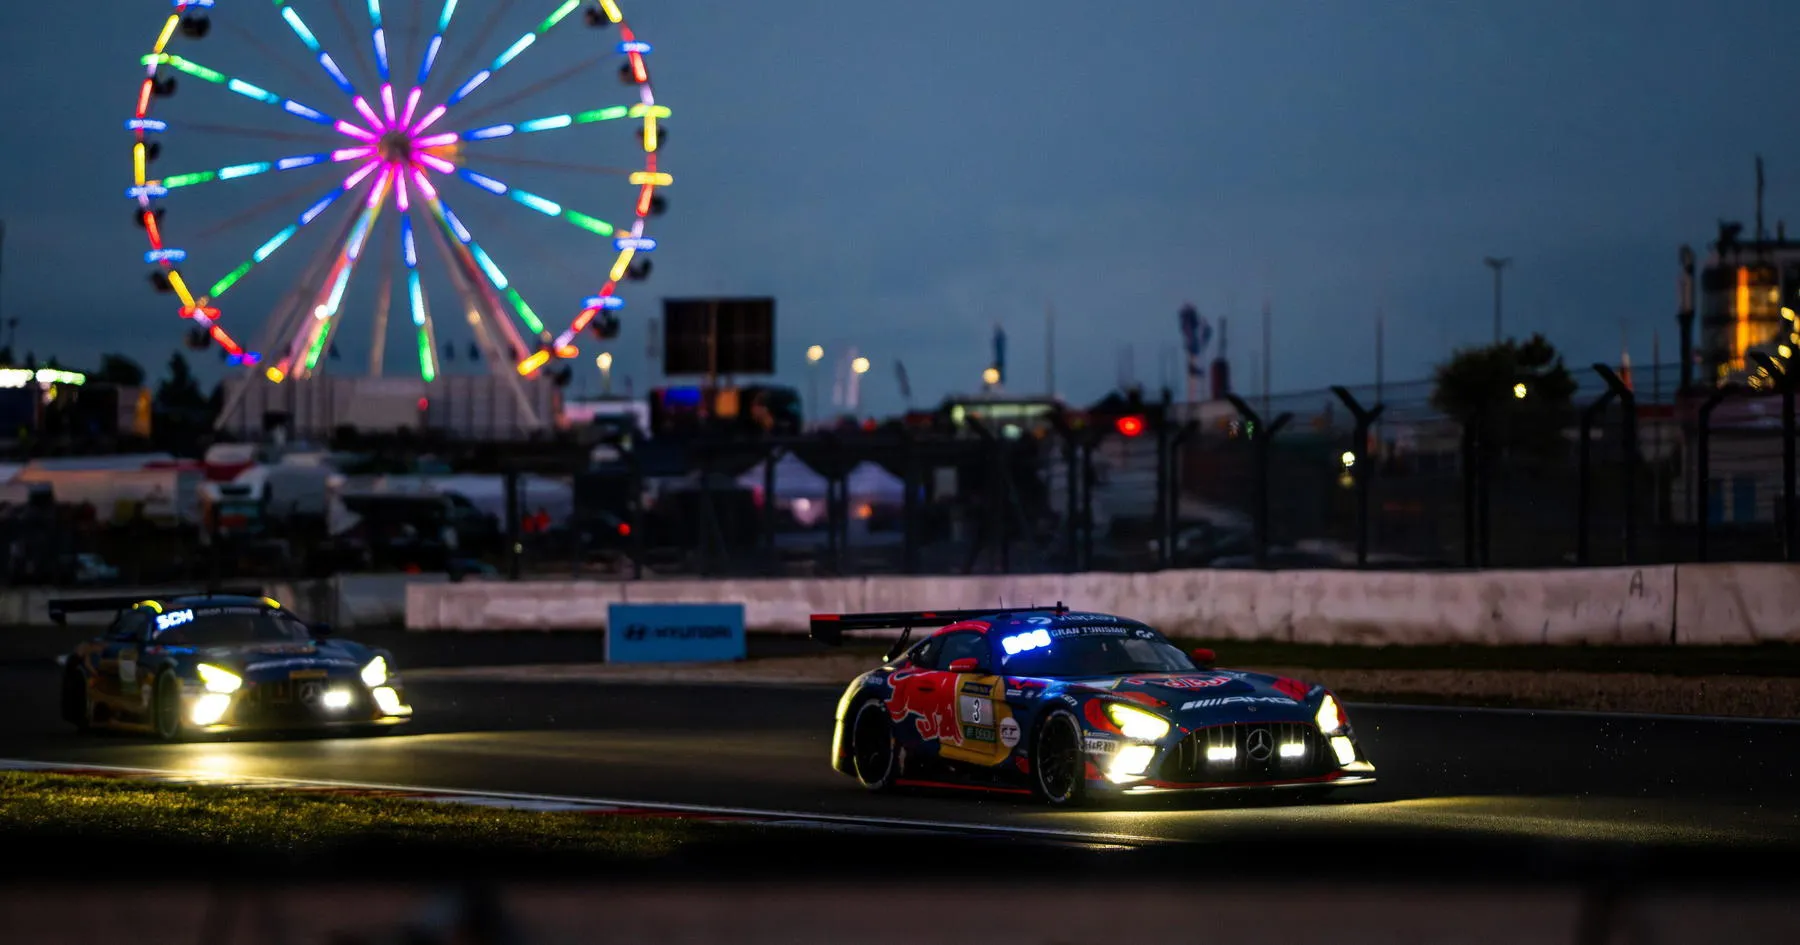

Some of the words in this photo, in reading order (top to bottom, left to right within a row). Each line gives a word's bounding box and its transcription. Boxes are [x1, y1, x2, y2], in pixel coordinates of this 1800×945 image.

[1051, 628, 1080, 637] GRAN
[1082, 626, 1129, 635] TURISMO
[973, 698, 981, 723] 3
